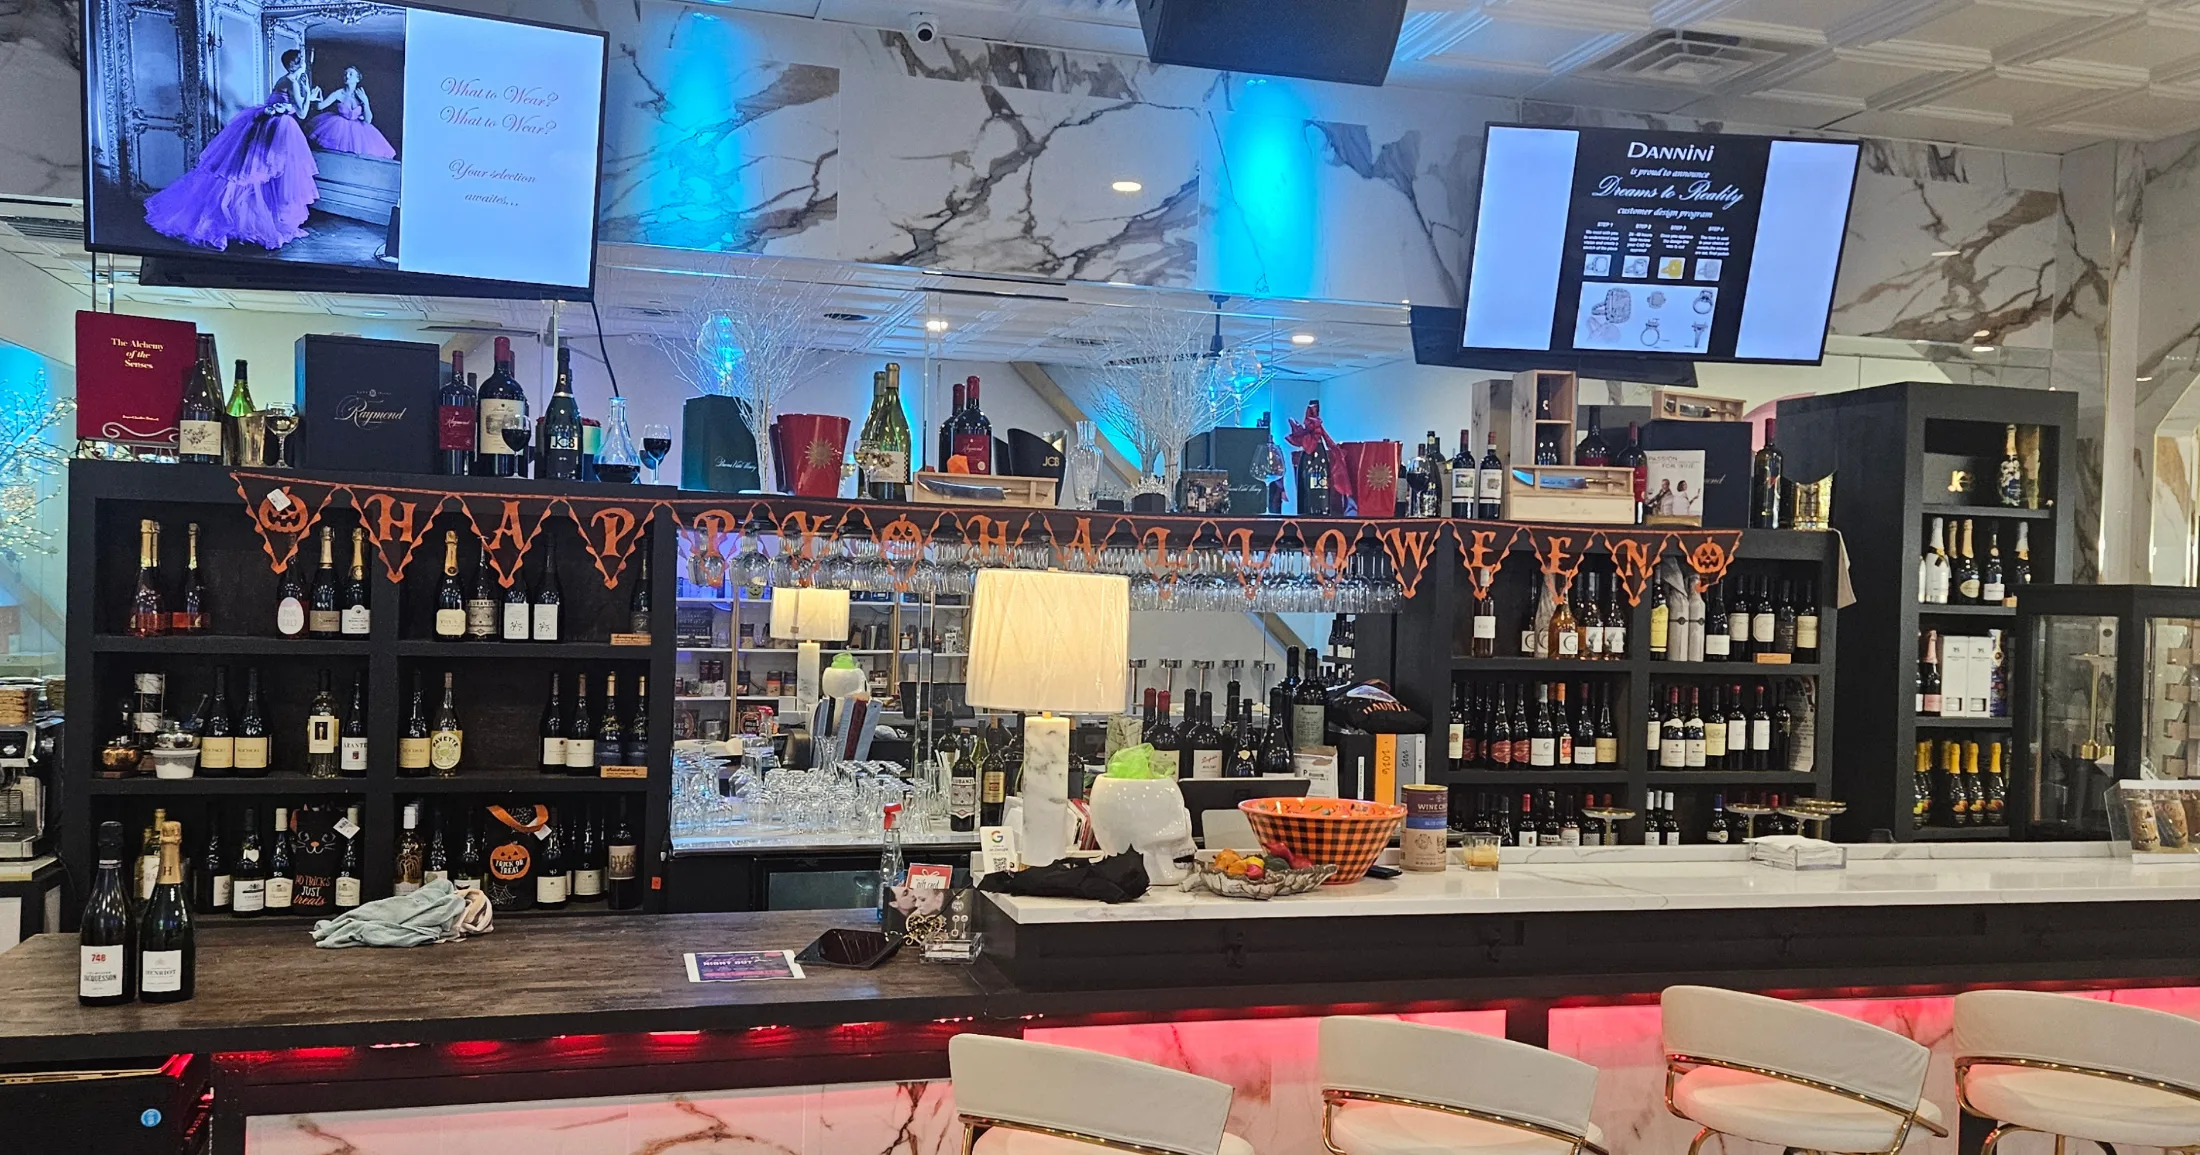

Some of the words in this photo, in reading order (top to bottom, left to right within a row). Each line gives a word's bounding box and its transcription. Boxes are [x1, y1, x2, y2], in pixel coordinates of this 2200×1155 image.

[440, 77, 483, 98] What
[485, 89, 497, 99] to
[503, 85, 559, 107] Wear?
[440, 105, 482, 127] What
[484, 118, 496, 128] to
[502, 114, 557, 135] Wear?
[448, 159, 488, 180] Your
[490, 168, 536, 183] selection
[1630, 167, 1637, 176] is
[1636, 168, 1663, 178] proud
[1663, 168, 1672, 177] to
[1672, 170, 1711, 179] announce
[1592, 175, 1658, 197] Dreams
[1660, 184, 1676, 199] to
[1679, 179, 1744, 210] Reality
[1617, 207, 1653, 217] customer
[1653, 207, 1678, 218] design
[1678, 210, 1713, 220] program
[111, 338, 128, 347] The
[131, 340, 164, 352] Alchemy
[126, 351, 137, 359] of
[137, 351, 151, 359] the
[124, 359, 154, 369] Senses
[334, 394, 407, 430] Raymond
[552, 436, 575, 448] JCB
[1042, 456, 1060, 467] JCB
[1381, 749, 1390, 775] 2026
[991, 830, 1004, 843] G
[495, 860, 514, 868] TRICK
[515, 859, 524, 867] OR
[163, 866, 172, 876] H
[500, 866, 519, 874] TREAT
[305, 875, 331, 887] TRICKS
[301, 885, 321, 898] JUST
[293, 894, 326, 906] treats
